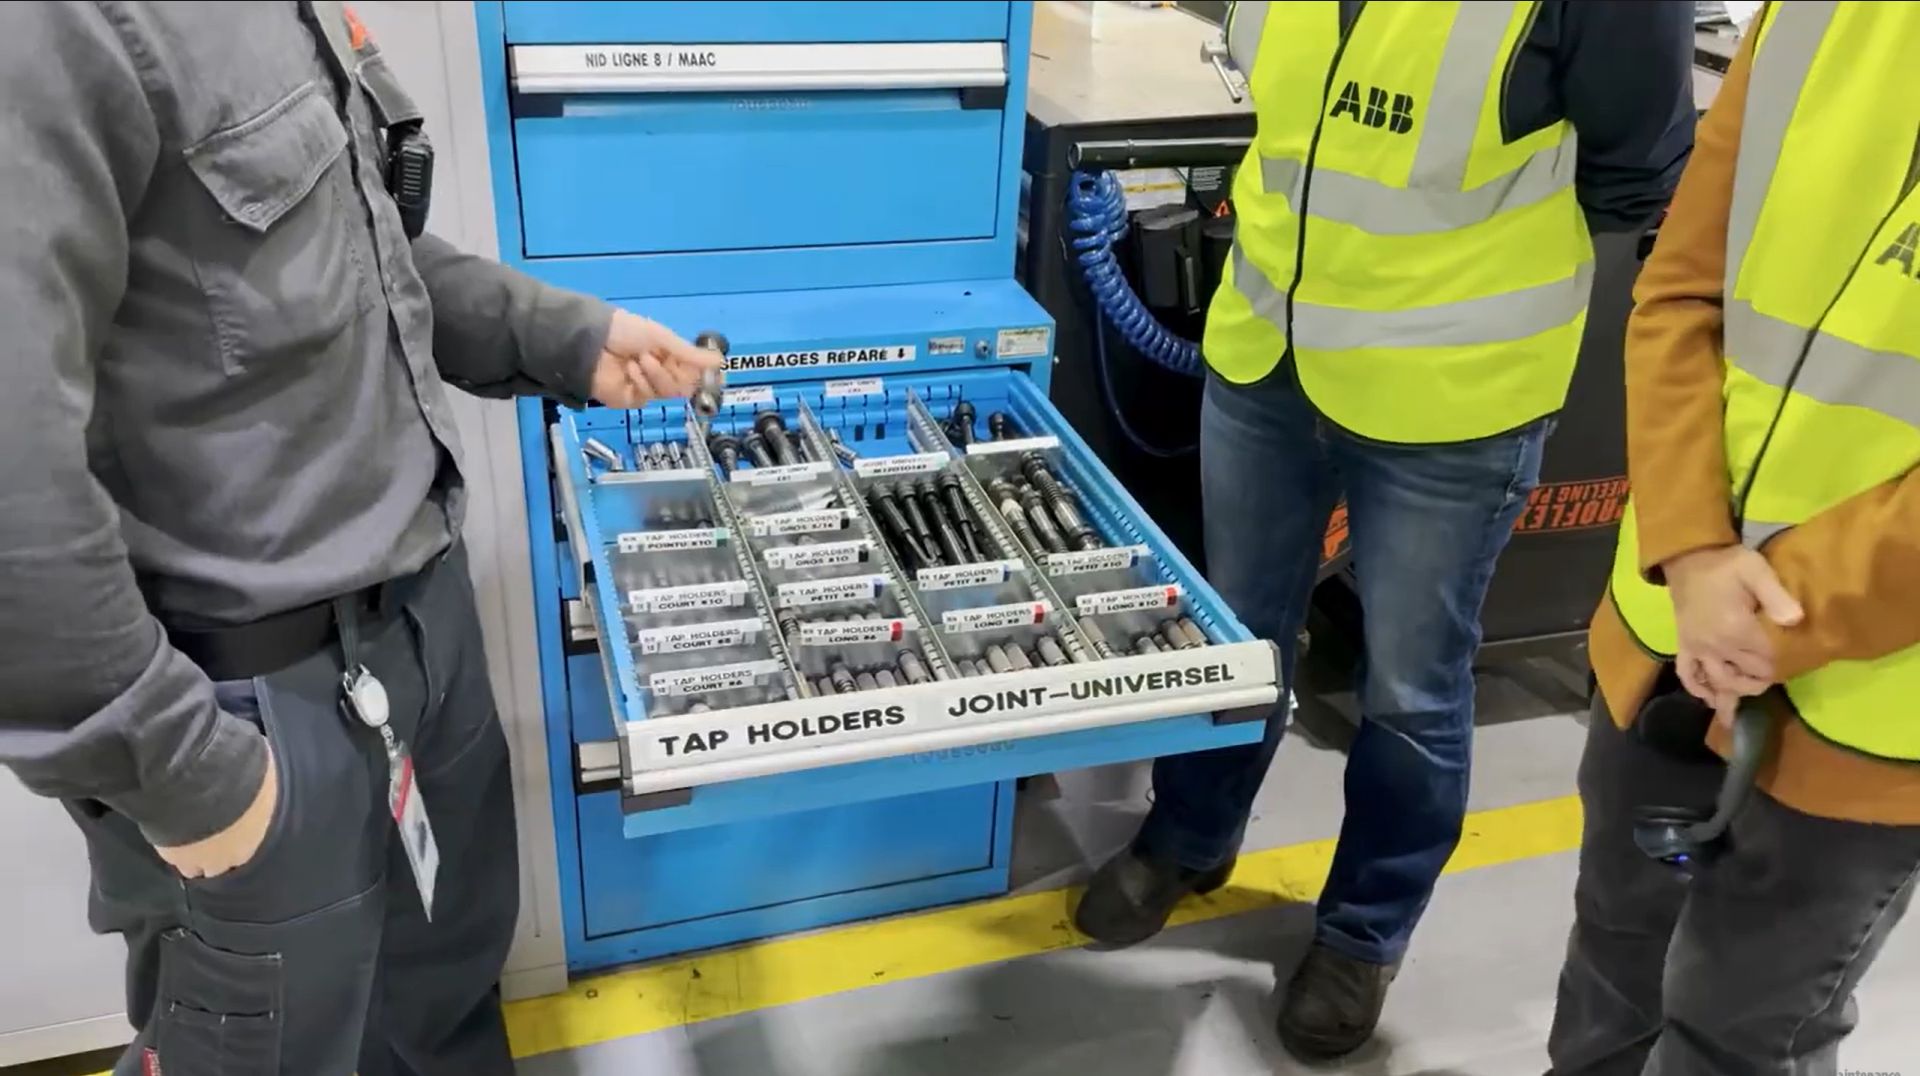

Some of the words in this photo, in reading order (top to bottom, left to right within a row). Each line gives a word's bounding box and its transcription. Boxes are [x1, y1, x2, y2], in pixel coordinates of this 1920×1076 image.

[586, 52, 607, 67] NID
[612, 52, 649, 67] LIGNE
[654, 52, 662, 66] 8
[667, 52, 672, 66] /
[678, 52, 716, 66] MAAC
[1329, 80, 1414, 134] ABB
[1874, 221, 1920, 279] A
[646, 534, 664, 542] TAP
[669, 531, 714, 540] HOLDERS
[811, 547, 855, 557] HOLDERS
[795, 558, 824, 566] GROS
[955, 567, 999, 578] HOLDERS
[823, 583, 869, 593] HOLDERS
[944, 578, 971, 587] PETIT
[654, 594, 674, 602] TAP
[678, 589, 728, 599] HOLDERS
[658, 600, 697, 610] COURT
[1107, 603, 1135, 611] LONG
[963, 614, 982, 622] TAP
[986, 608, 1032, 620] HOLDERS
[842, 625, 890, 634] HOLDERS
[974, 620, 1003, 629] LONG
[664, 633, 686, 642] TAP
[690, 628, 741, 639] HOLDERS
[829, 635, 860, 643] LONG
[673, 640, 713, 650] COURT
[673, 677, 696, 686] TAP
[700, 669, 753, 681] HOLDERS
[682, 682, 723, 693] COURT
[658, 729, 729, 756] TAP
[747, 705, 906, 745] HOLDERS
